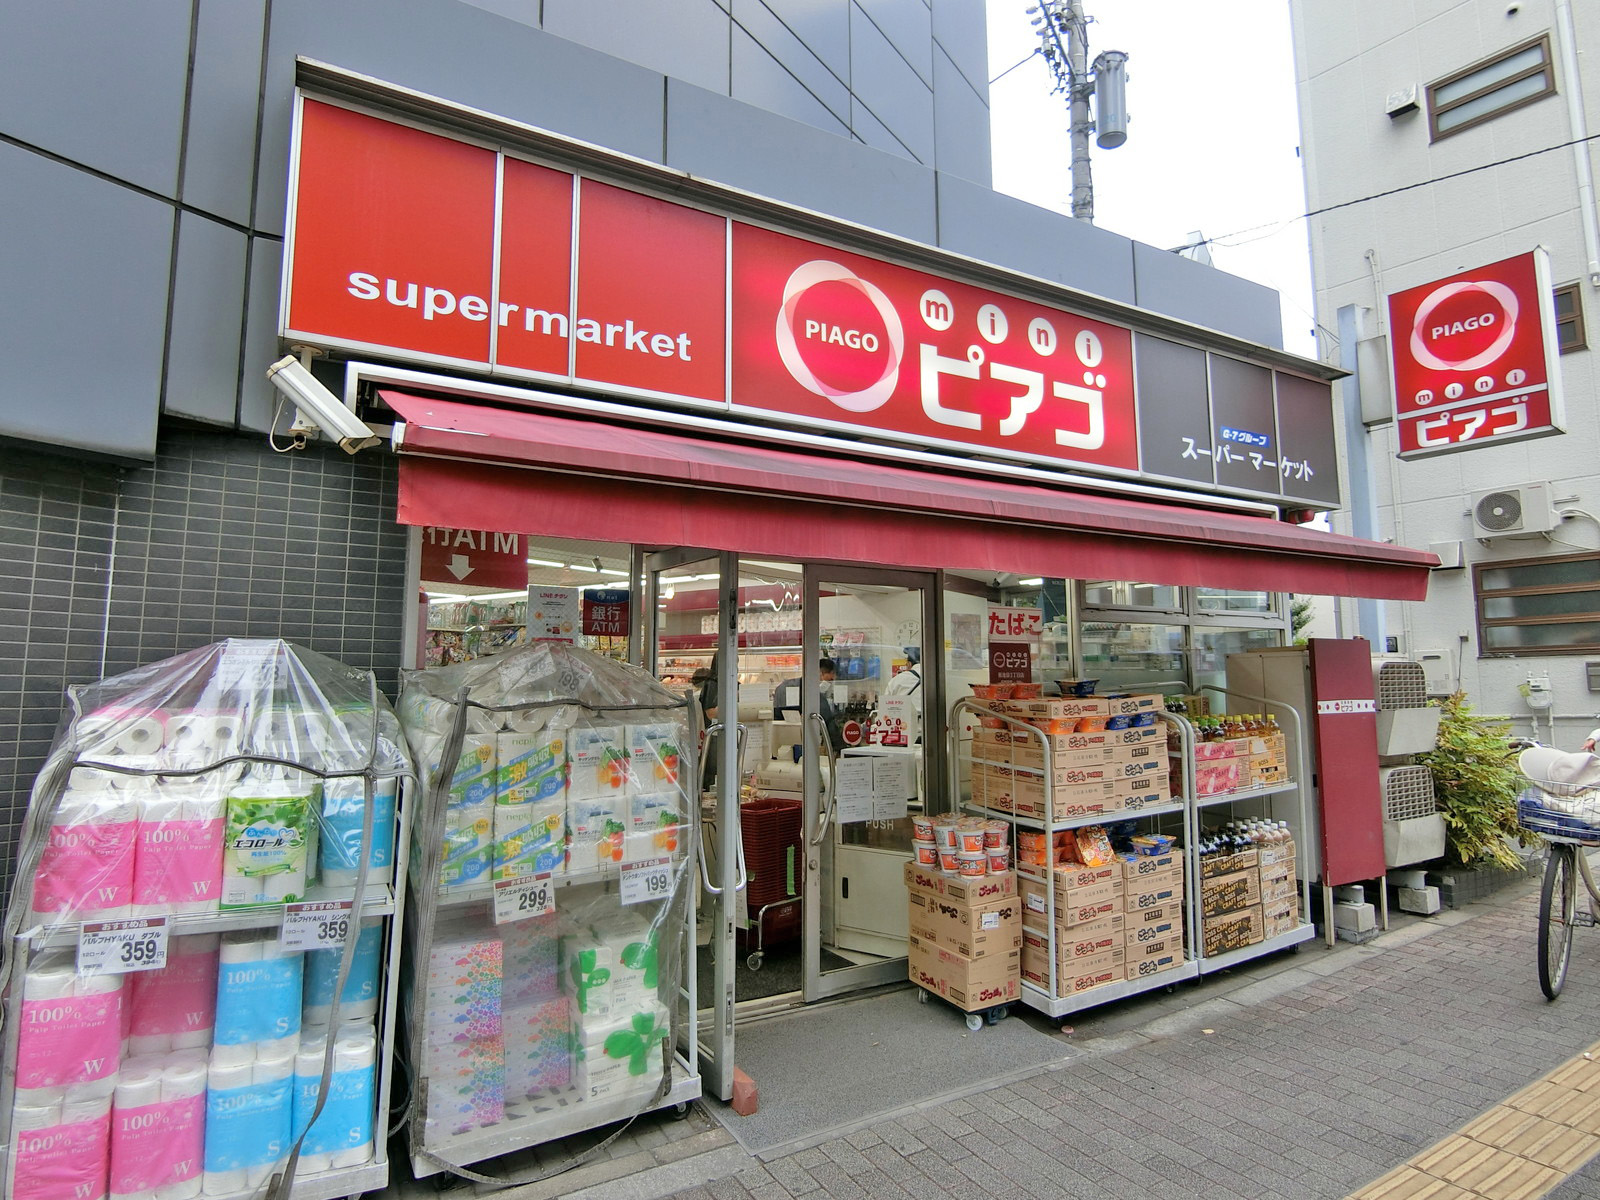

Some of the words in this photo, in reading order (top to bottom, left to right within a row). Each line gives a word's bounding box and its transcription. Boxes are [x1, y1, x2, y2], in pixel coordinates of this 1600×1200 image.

[347, 271, 692, 361] supermarket
[924, 296, 1093, 361] mini
[1431, 312, 1495, 340] PIAGO
[806, 320, 879, 353] PIAGO
[1418, 372, 1518, 402] mini
[920, 343, 1106, 450] ピアゴ
[1416, 395, 1528, 448] ピアゴ
[591, 605, 621, 621] 銀行
[591, 621, 621, 633] ATM
[989, 612, 1043, 635] たばこ
[866, 820, 894, 831] PUSH
[144, 829, 190, 844] 100%
[233, 839, 284, 848] エコロール
[98, 886, 119, 901] W
[193, 880, 212, 895] W
[302, 903, 342, 911] おすすめ品
[101, 920, 149, 931] おすすめ品
[141, 931, 162, 940] ダブル
[227, 969, 271, 985] 100%
[29, 1005, 81, 1024] 100%
[186, 1012, 204, 1026] W
[276, 1017, 289, 1033] S
[83, 1057, 105, 1075] W
[302, 1081, 344, 1098] 10%
[121, 1111, 170, 1131] 100%
[19, 1131, 72, 1154] 100%
[349, 1127, 361, 1143] S
[268, 1140, 280, 1157] S
[173, 1158, 193, 1177] W
[75, 1181, 97, 1199] W
